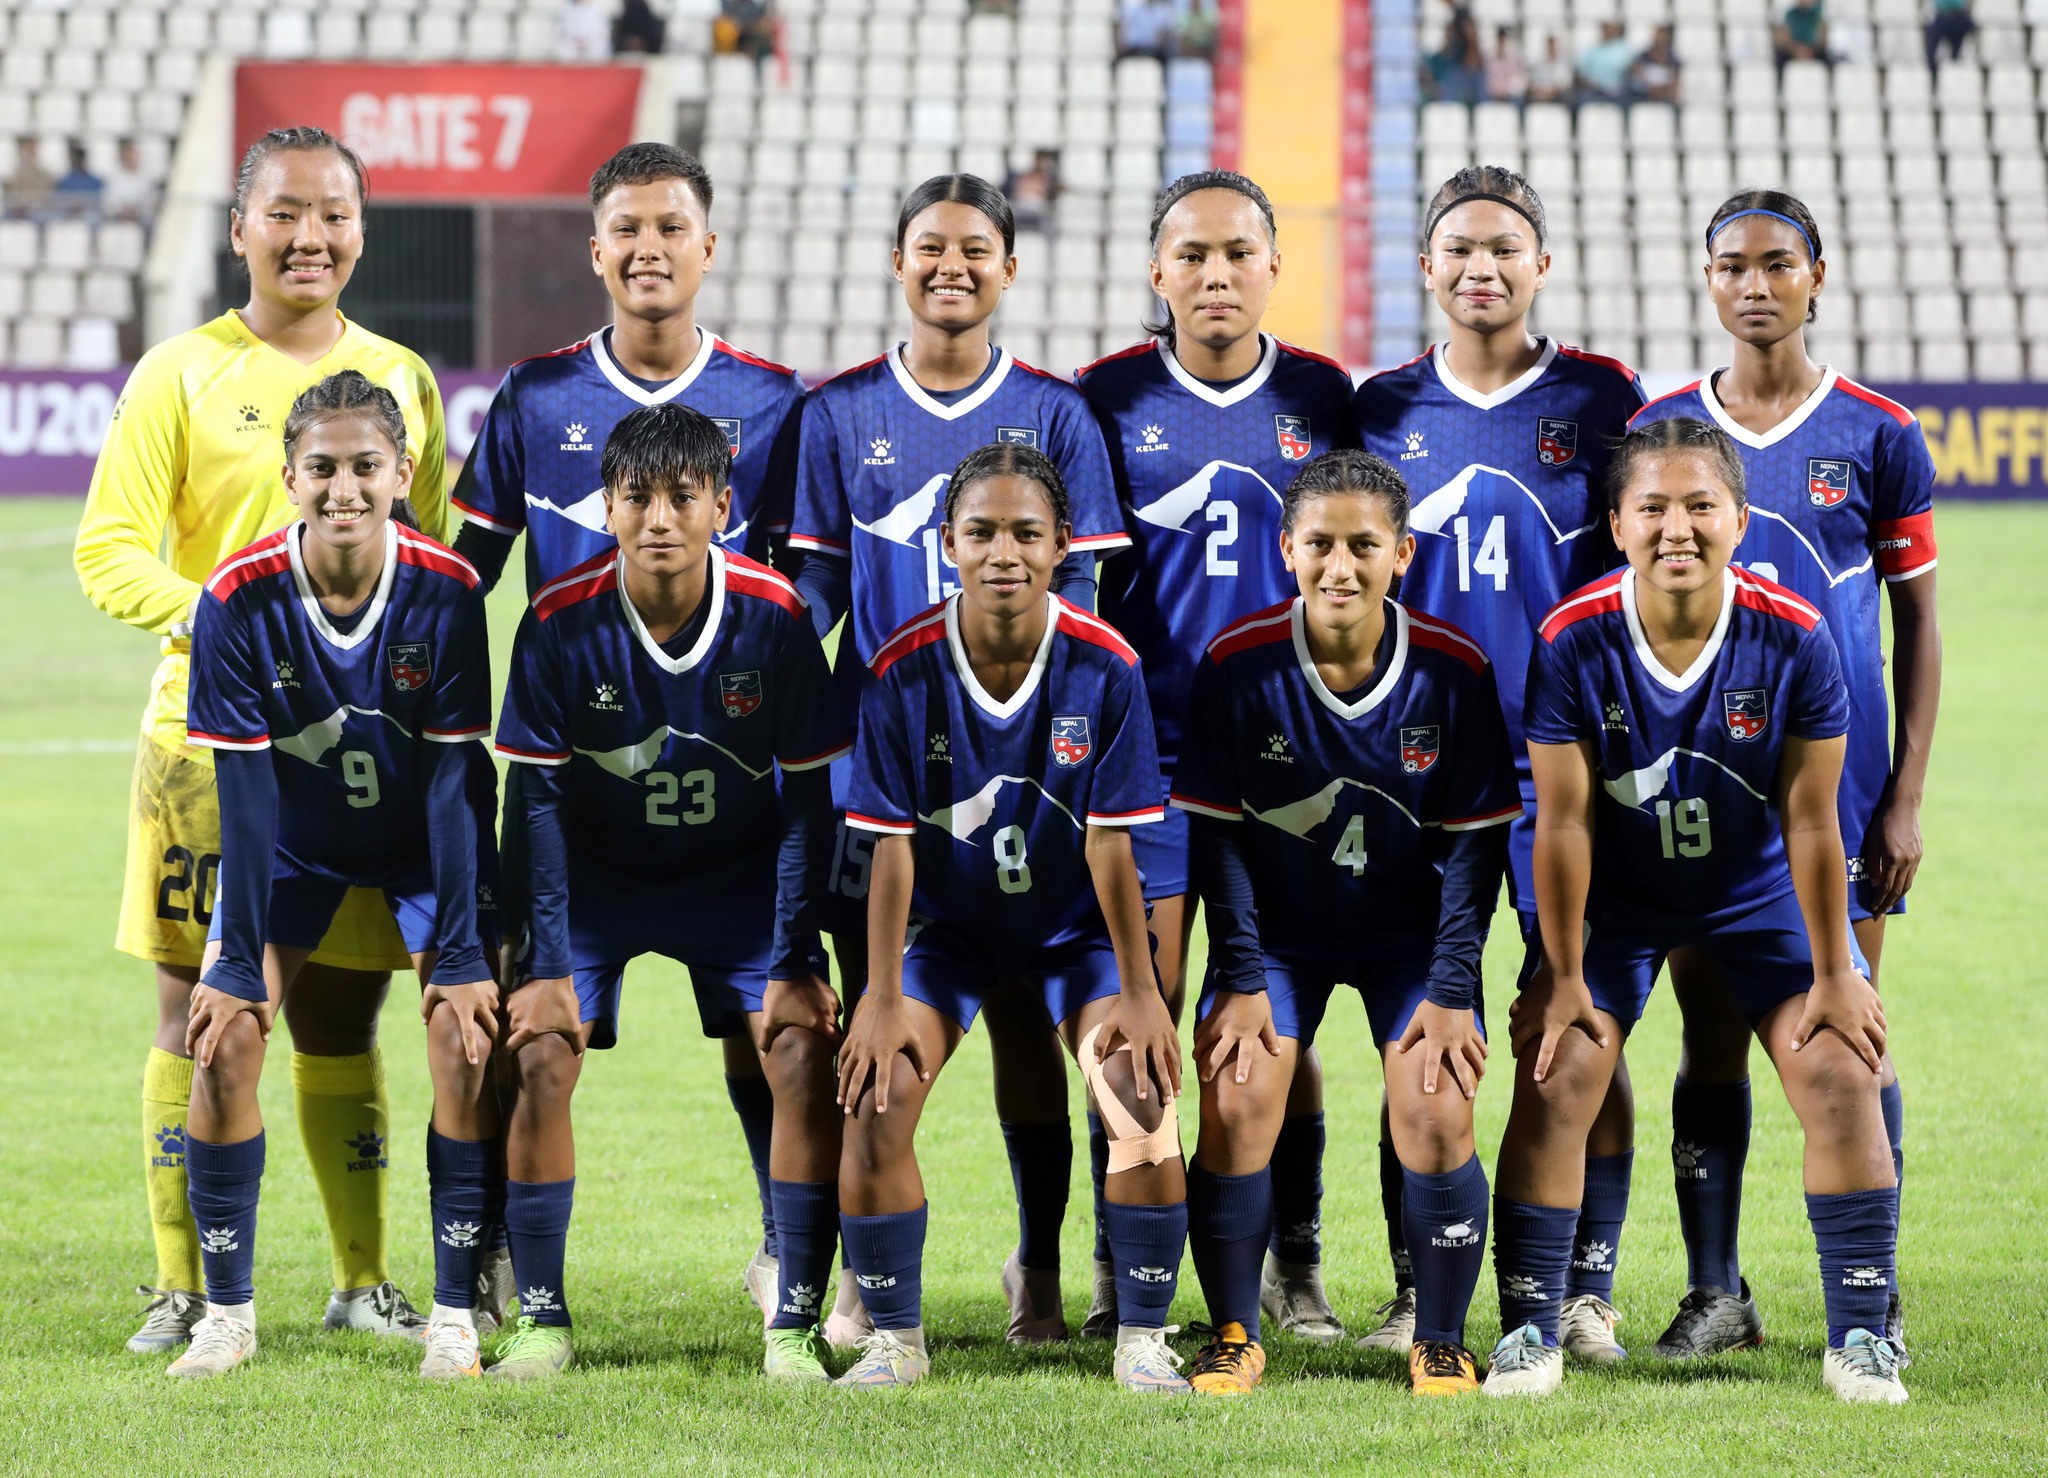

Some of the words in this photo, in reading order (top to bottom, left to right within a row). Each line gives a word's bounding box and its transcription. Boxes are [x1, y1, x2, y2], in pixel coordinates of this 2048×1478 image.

[343, 94, 483, 170] GATE
[491, 96, 532, 170] 7
[0, 382, 115, 457] U20
[236, 424, 273, 432] KELME
[1549, 422, 1568, 430] NEPAL
[1135, 443, 1169, 453] KELME
[864, 457, 895, 465] KELME
[1400, 450, 1428, 461] KELME
[1819, 462, 1840, 470] NEPAL
[1205, 500, 1239, 577] 2
[1453, 515, 1509, 591] 14
[398, 646, 418, 654] NEPAL
[272, 680, 302, 690] KELME
[1735, 693, 1756, 701] NEPAL
[588, 701, 624, 711] KELME
[1411, 728, 1430, 736] NEPAL
[1602, 723, 1629, 733] KELME
[926, 753, 953, 763] KELME
[1260, 752, 1294, 763] KELME
[342, 750, 381, 808] 9
[645, 769, 717, 826] 23
[1655, 797, 1712, 859] 19
[1331, 814, 1367, 877] 4
[828, 820, 875, 899] 15
[993, 824, 1034, 894] 8
[157, 846, 221, 926] 20
[201, 1241, 238, 1253] KELME
[441, 1235, 479, 1248] KELME
[1432, 1235, 1479, 1248] KELME
[1573, 1260, 1612, 1272] KELME
[1130, 1268, 1172, 1282] KELME
[856, 1275, 895, 1288] KELME
[1842, 1277, 1886, 1286] KELME
[783, 1304, 819, 1315] KELME
